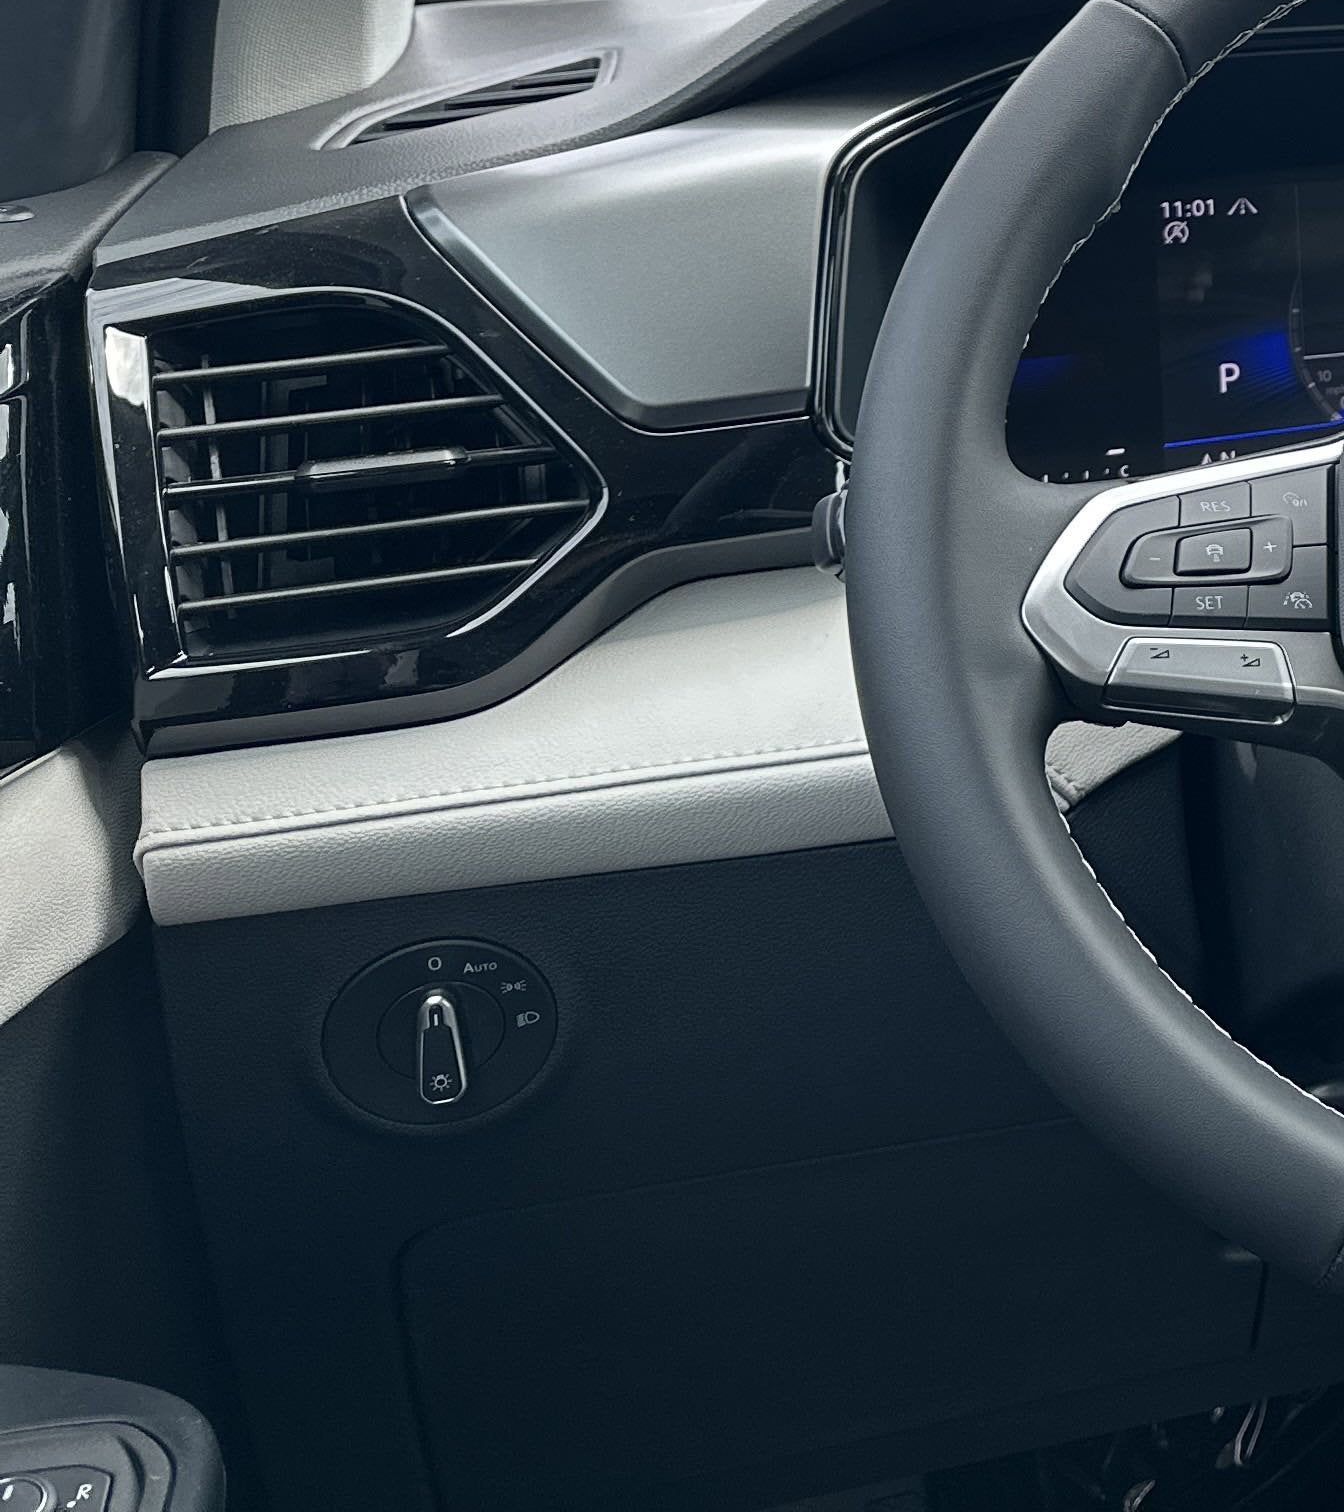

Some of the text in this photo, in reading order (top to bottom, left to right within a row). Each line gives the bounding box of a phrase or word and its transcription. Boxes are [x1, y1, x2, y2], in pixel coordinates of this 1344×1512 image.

[1160, 199, 1215, 218] 11:01
[1219, 363, 1240, 393] P
[1317, 369, 1332, 382] 10
[1200, 501, 1231, 513] RES
[1196, 595, 1224, 610] SET
[76, 1483, 92, 1500] R
